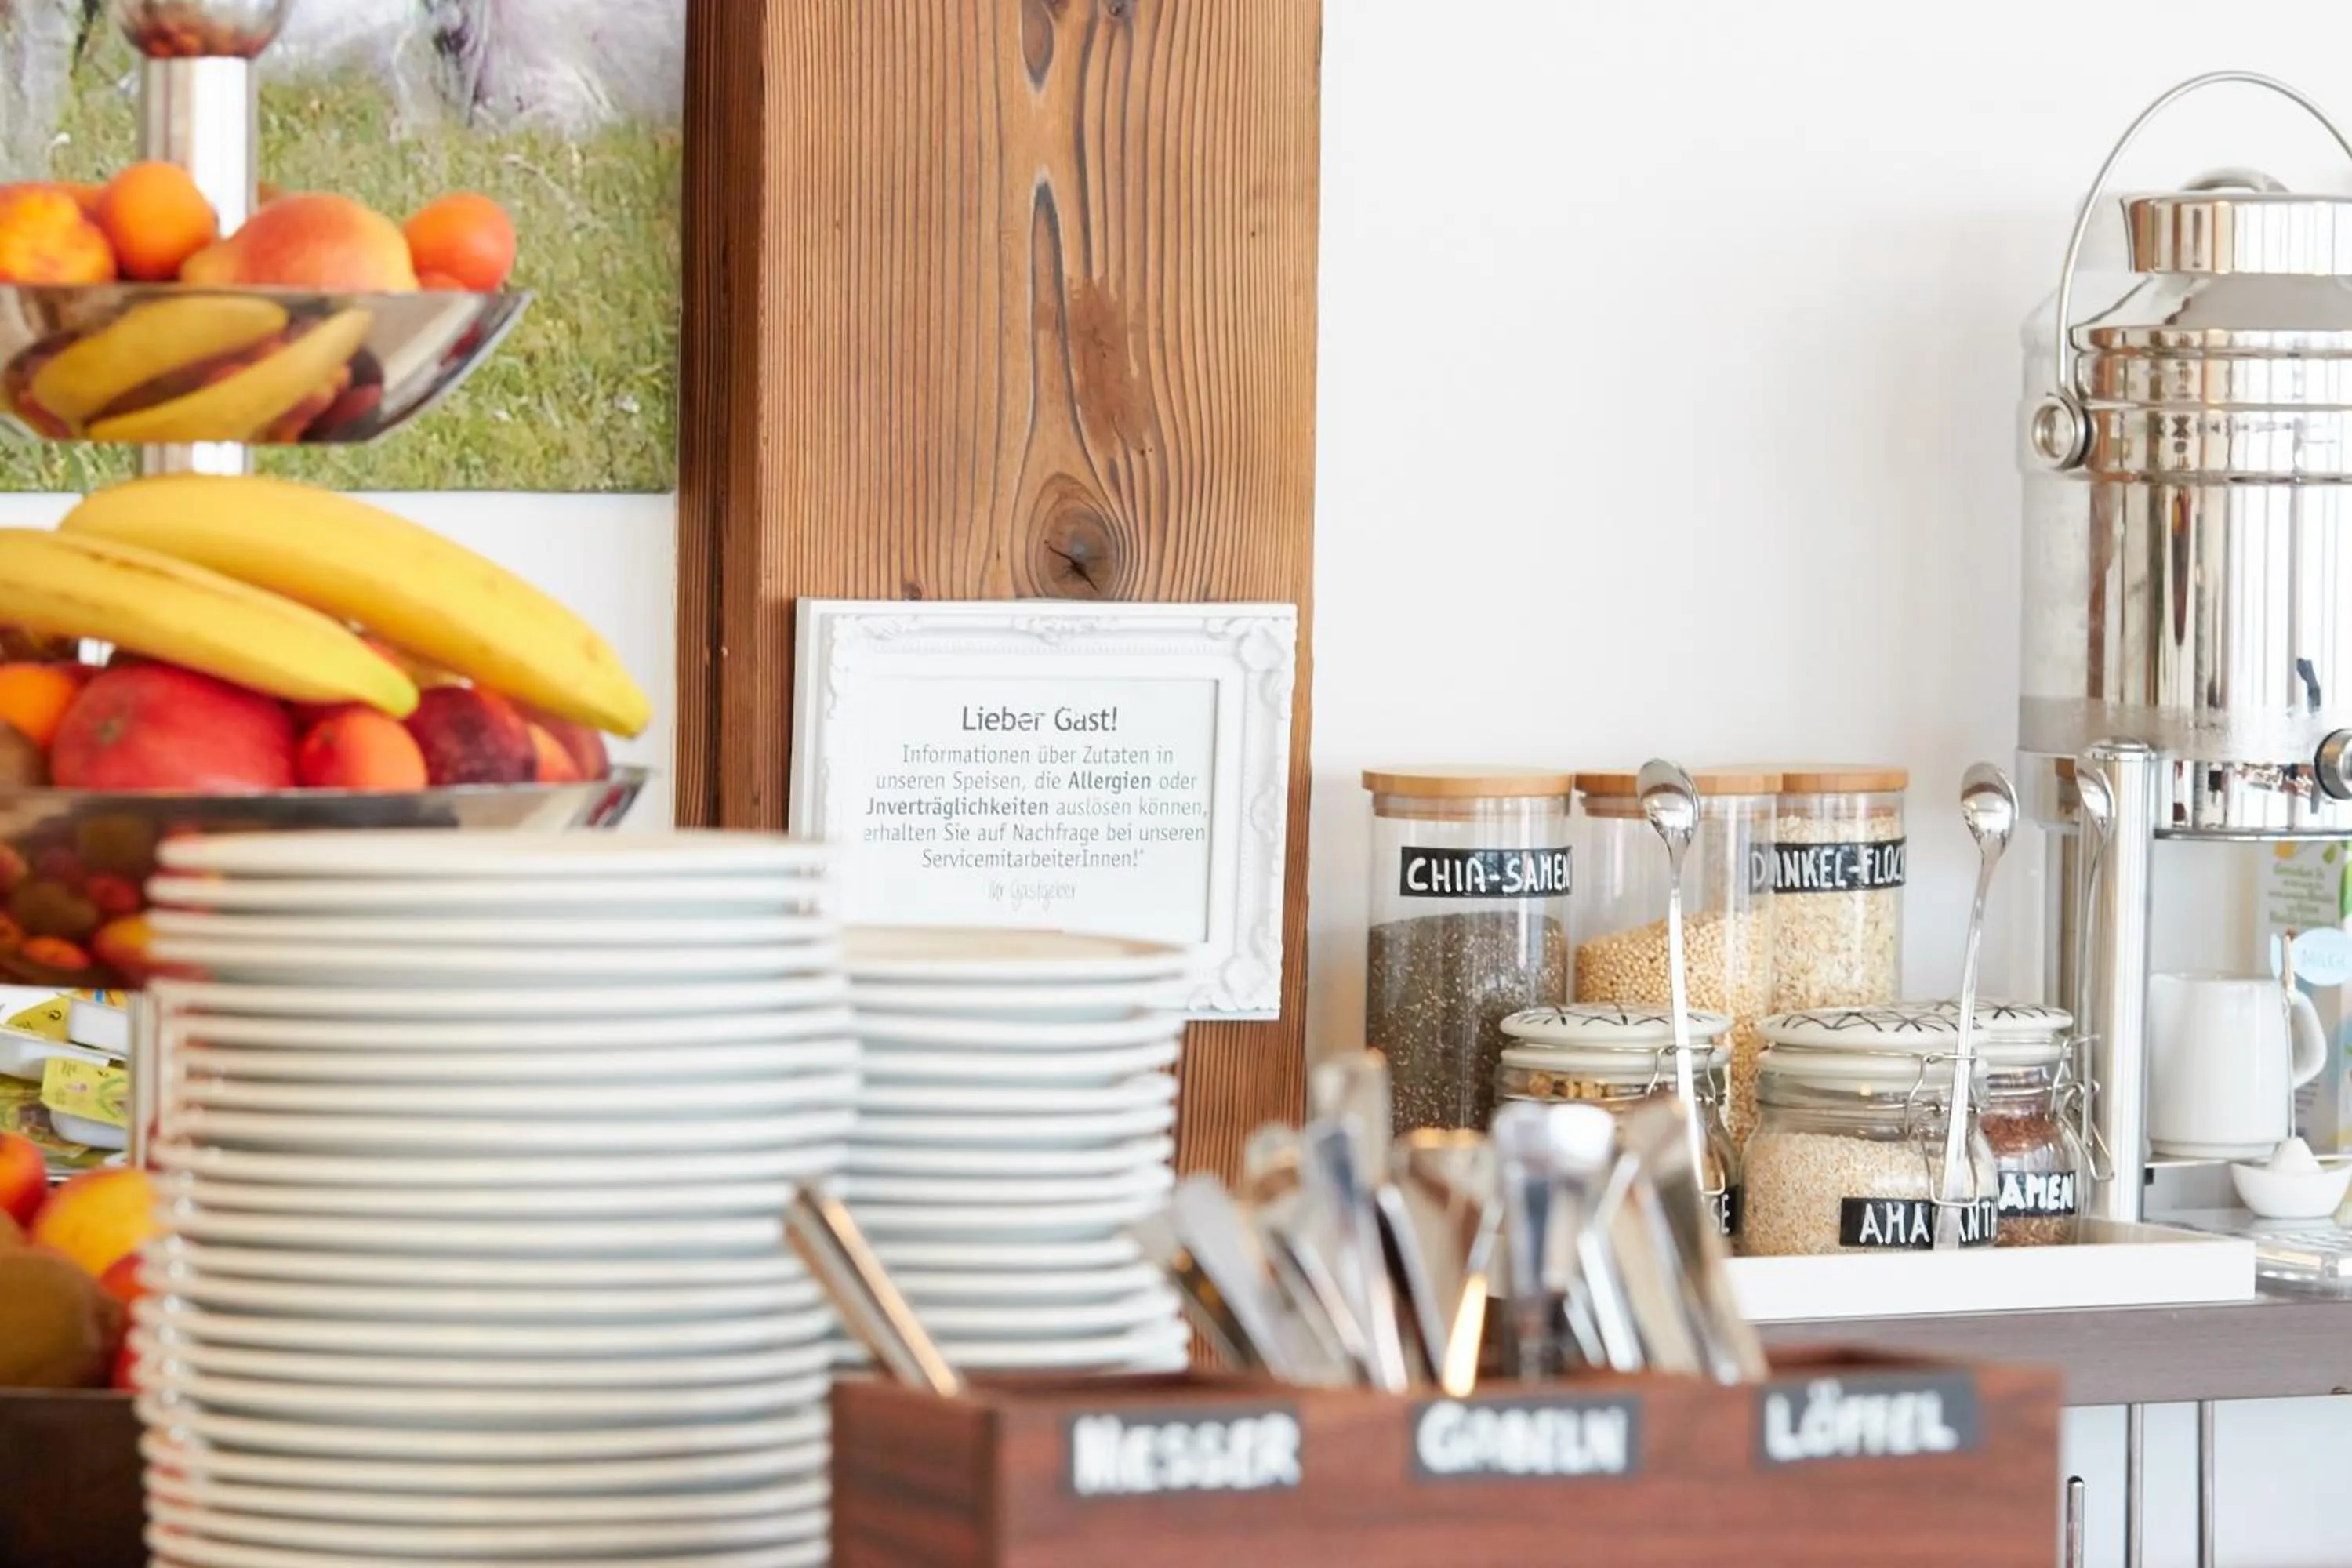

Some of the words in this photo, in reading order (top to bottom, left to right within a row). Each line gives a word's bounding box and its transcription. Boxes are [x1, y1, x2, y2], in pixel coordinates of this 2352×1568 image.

[961, 706, 1045, 732] Lieber
[1054, 706, 1119, 732] Gast!
[902, 743, 1031, 765] Informationen
[1037, 745, 1076, 765] über
[1082, 746, 1150, 766] Zutaten
[1156, 746, 1174, 765] in
[875, 773, 946, 791] unseren
[953, 771, 1027, 797] Speisen,
[1034, 771, 1062, 791] die
[1067, 771, 1152, 795] Allergien
[1158, 771, 1199, 791] oder
[1055, 797, 1132, 817] auslösen
[1138, 797, 1210, 821] können,
[863, 822, 937, 842] erhalten
[943, 822, 971, 842] Sie
[977, 822, 1007, 842] auf
[1012, 822, 1100, 846] Nachfrage
[1105, 822, 1133, 842] bei
[1138, 825, 1206, 842] unseren
[1998, 1173, 2075, 1210] AMEN
[1859, 1200, 1998, 1245] AMANTH
